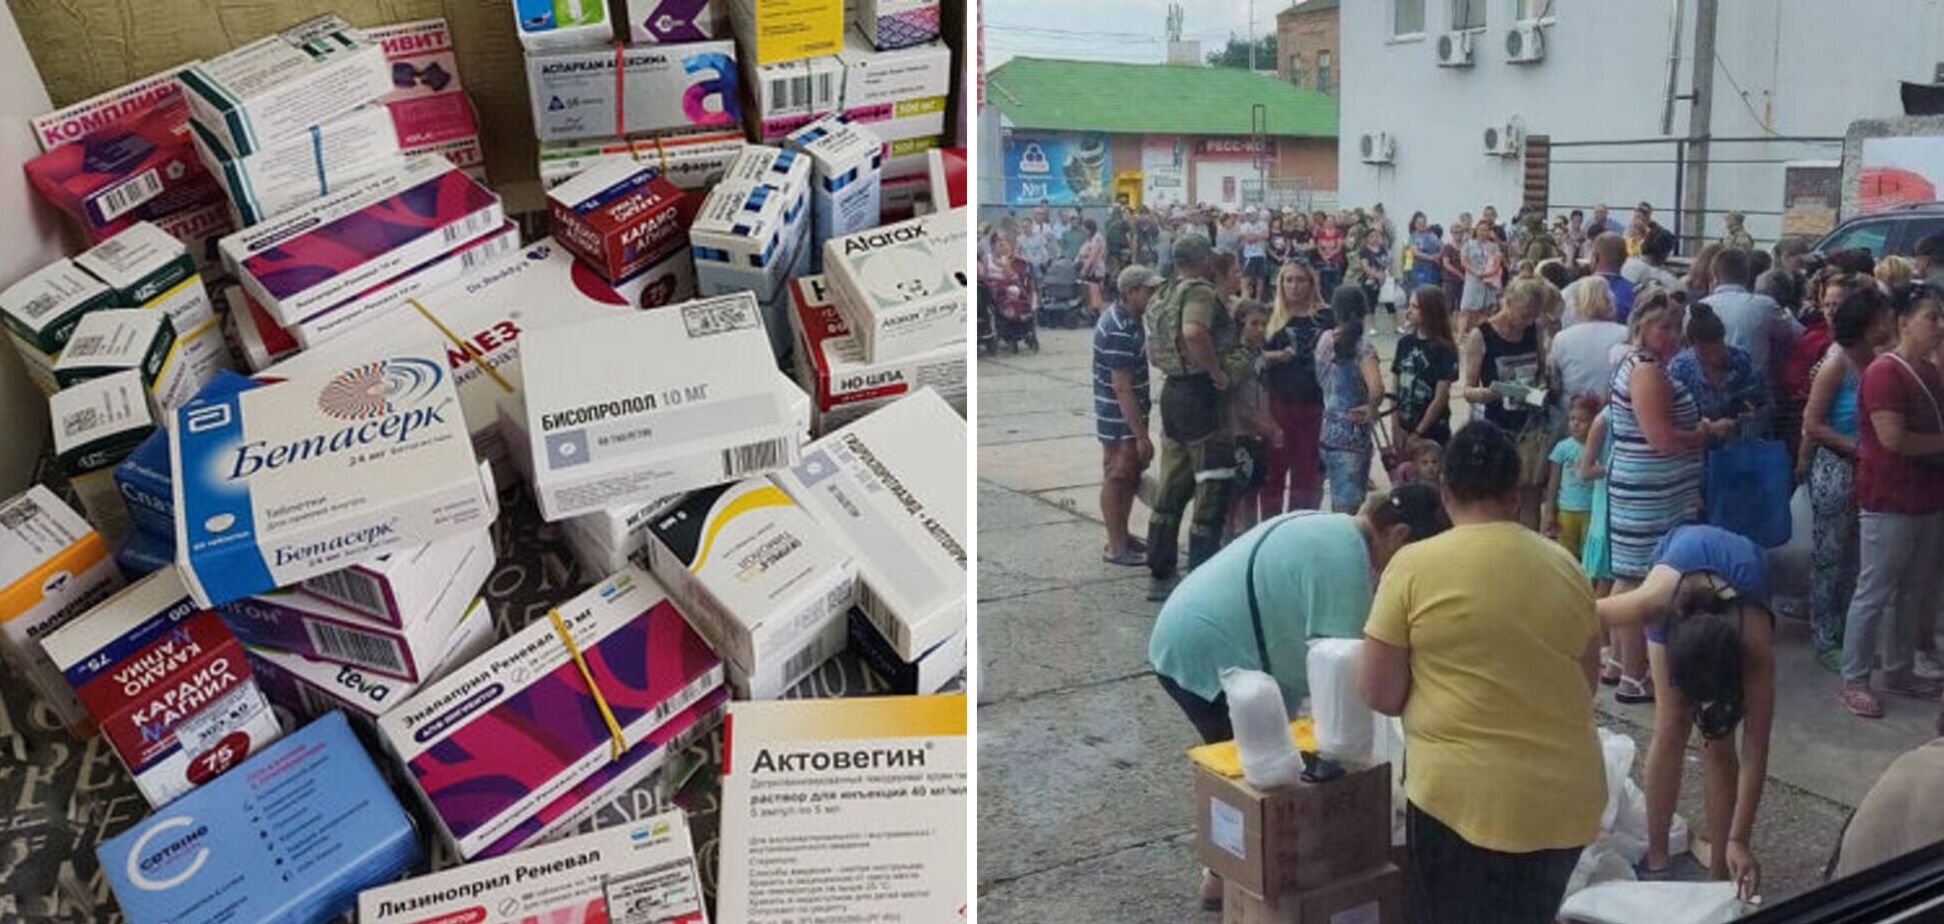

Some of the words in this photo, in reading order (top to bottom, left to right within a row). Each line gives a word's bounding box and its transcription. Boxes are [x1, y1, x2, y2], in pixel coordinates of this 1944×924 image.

[381, 31, 445, 53] ИВИТ
[541, 58, 605, 75] АСПАРКАМ
[620, 206, 678, 245] КАРДИО
[844, 224, 927, 255] Atarax
[446, 320, 523, 369] МЕЗ
[541, 393, 657, 432] БИСОПРОЛОЛ
[662, 389, 683, 406] 10
[684, 383, 708, 400] МГ
[226, 397, 453, 481] Бетасерк
[275, 520, 394, 567] Бетасерк
[87, 653, 112, 672] 75
[123, 641, 202, 696] КАРДИО
[402, 671, 491, 729] Эналаприл
[490, 632, 554, 674] Реневал
[575, 608, 592, 623] мг
[131, 657, 230, 727] КАРДИО
[336, 664, 391, 702] teva
[139, 673, 237, 744] МАГНИЛ
[202, 745, 234, 771] 75
[751, 748, 926, 774] Актовегин
[749, 793, 807, 806] раствор
[809, 791, 837, 803] для
[840, 788, 907, 800] инъекций
[911, 785, 927, 797] 40
[749, 808, 758, 818] 5
[760, 806, 796, 818] ампул
[798, 806, 813, 816] по
[814, 804, 822, 815] 5
[377, 873, 511, 919] Лизиноприл
[514, 849, 601, 883] Реневал
